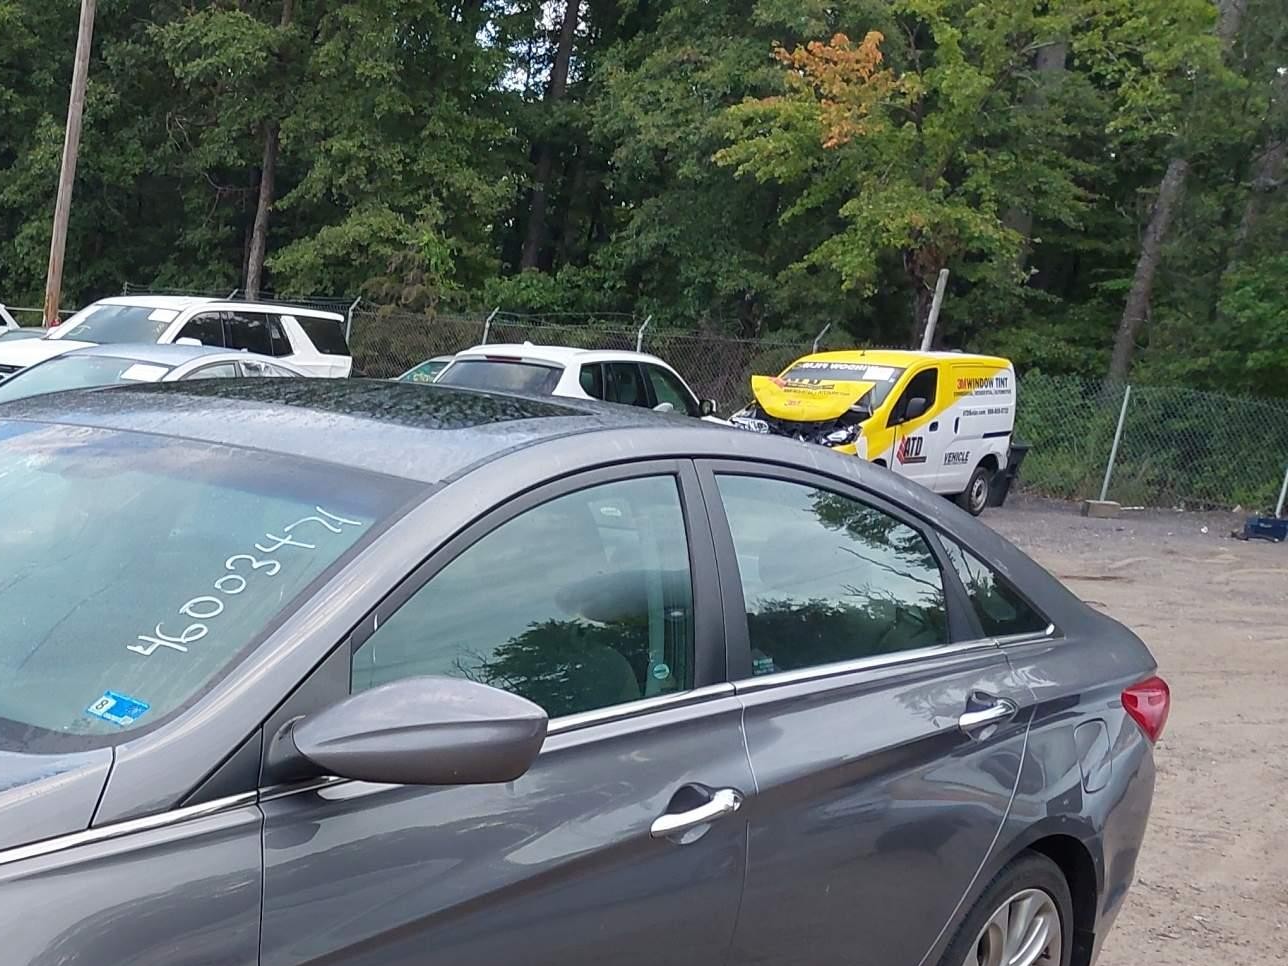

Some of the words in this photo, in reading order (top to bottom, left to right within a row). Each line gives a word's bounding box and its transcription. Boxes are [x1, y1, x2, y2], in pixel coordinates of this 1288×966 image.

[967, 377, 994, 390] WINDOW
[995, 376, 1008, 389] TINT
[904, 436, 924, 457] ATD
[126, 506, 362, 656] 46003471
